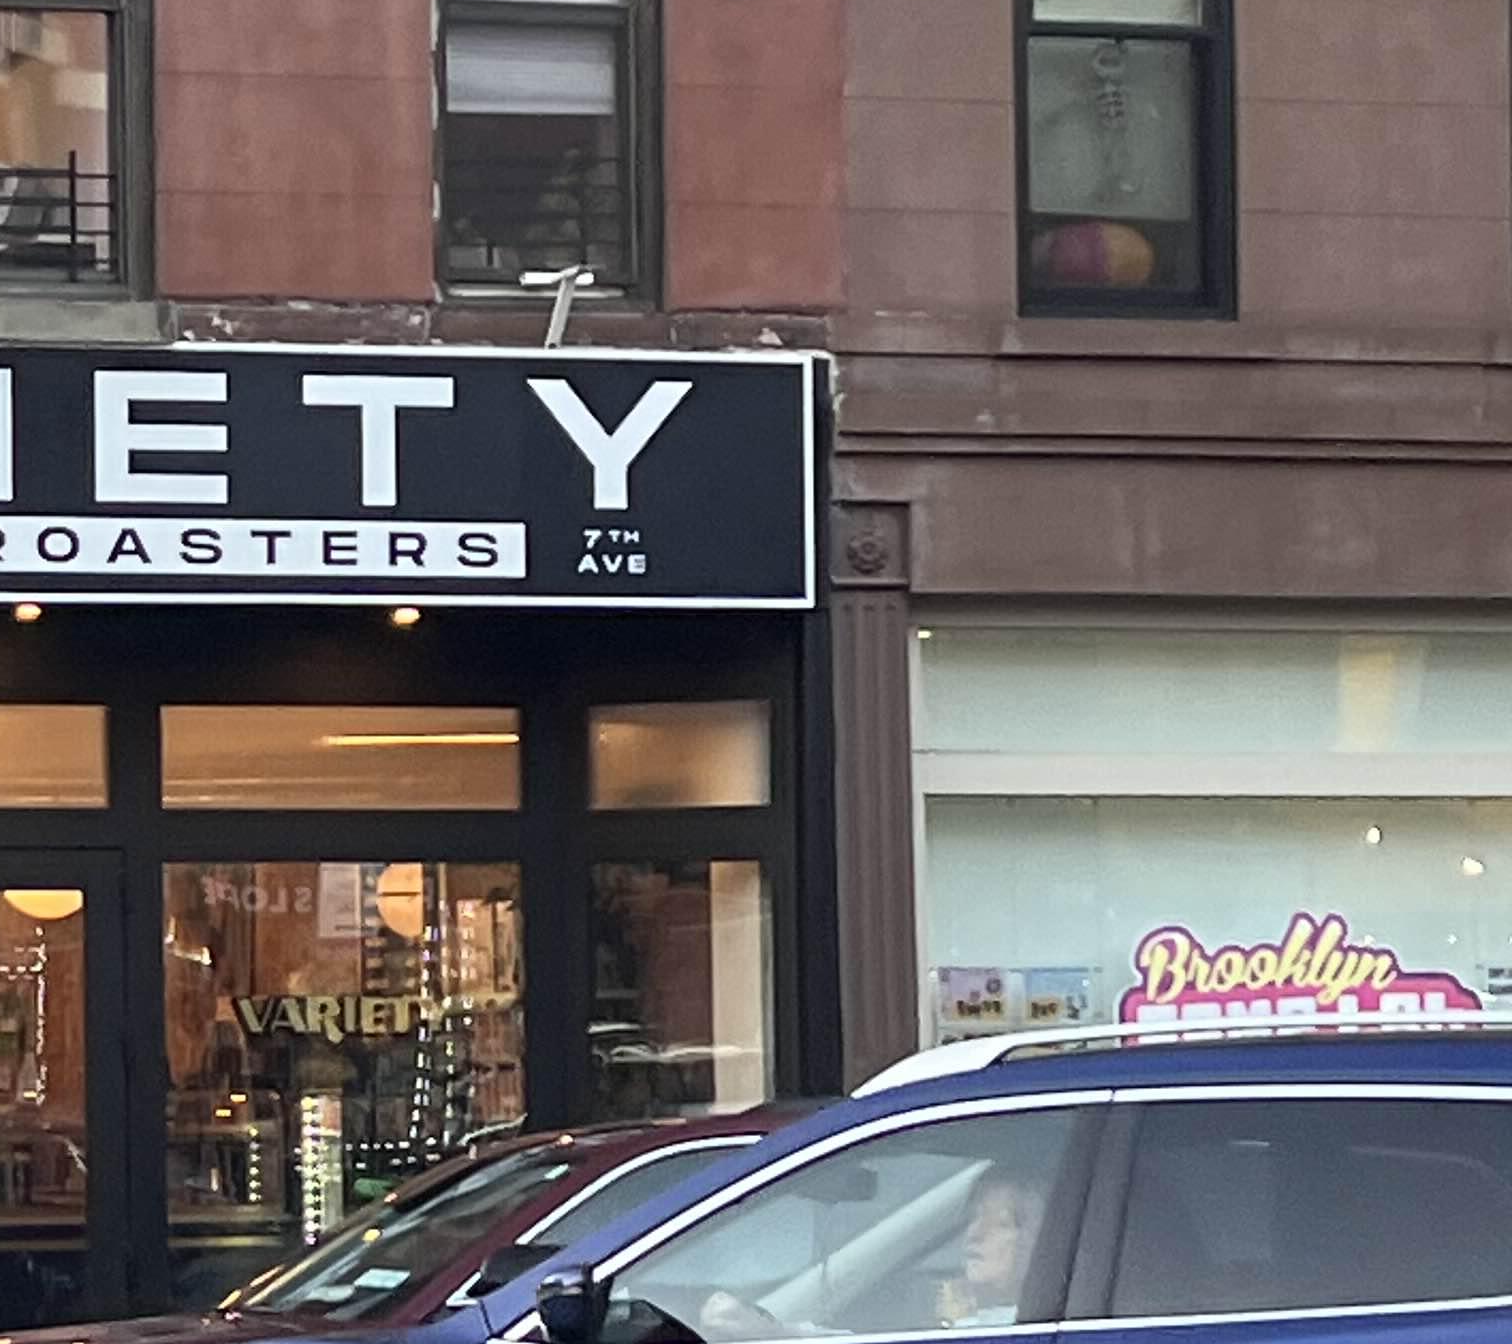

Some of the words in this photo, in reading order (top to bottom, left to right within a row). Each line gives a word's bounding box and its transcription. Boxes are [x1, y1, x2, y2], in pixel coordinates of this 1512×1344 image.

[577, 552, 647, 575] AVE
[1143, 916, 1397, 1004] Brooklyn
[237, 994, 450, 1043] VARIETY
